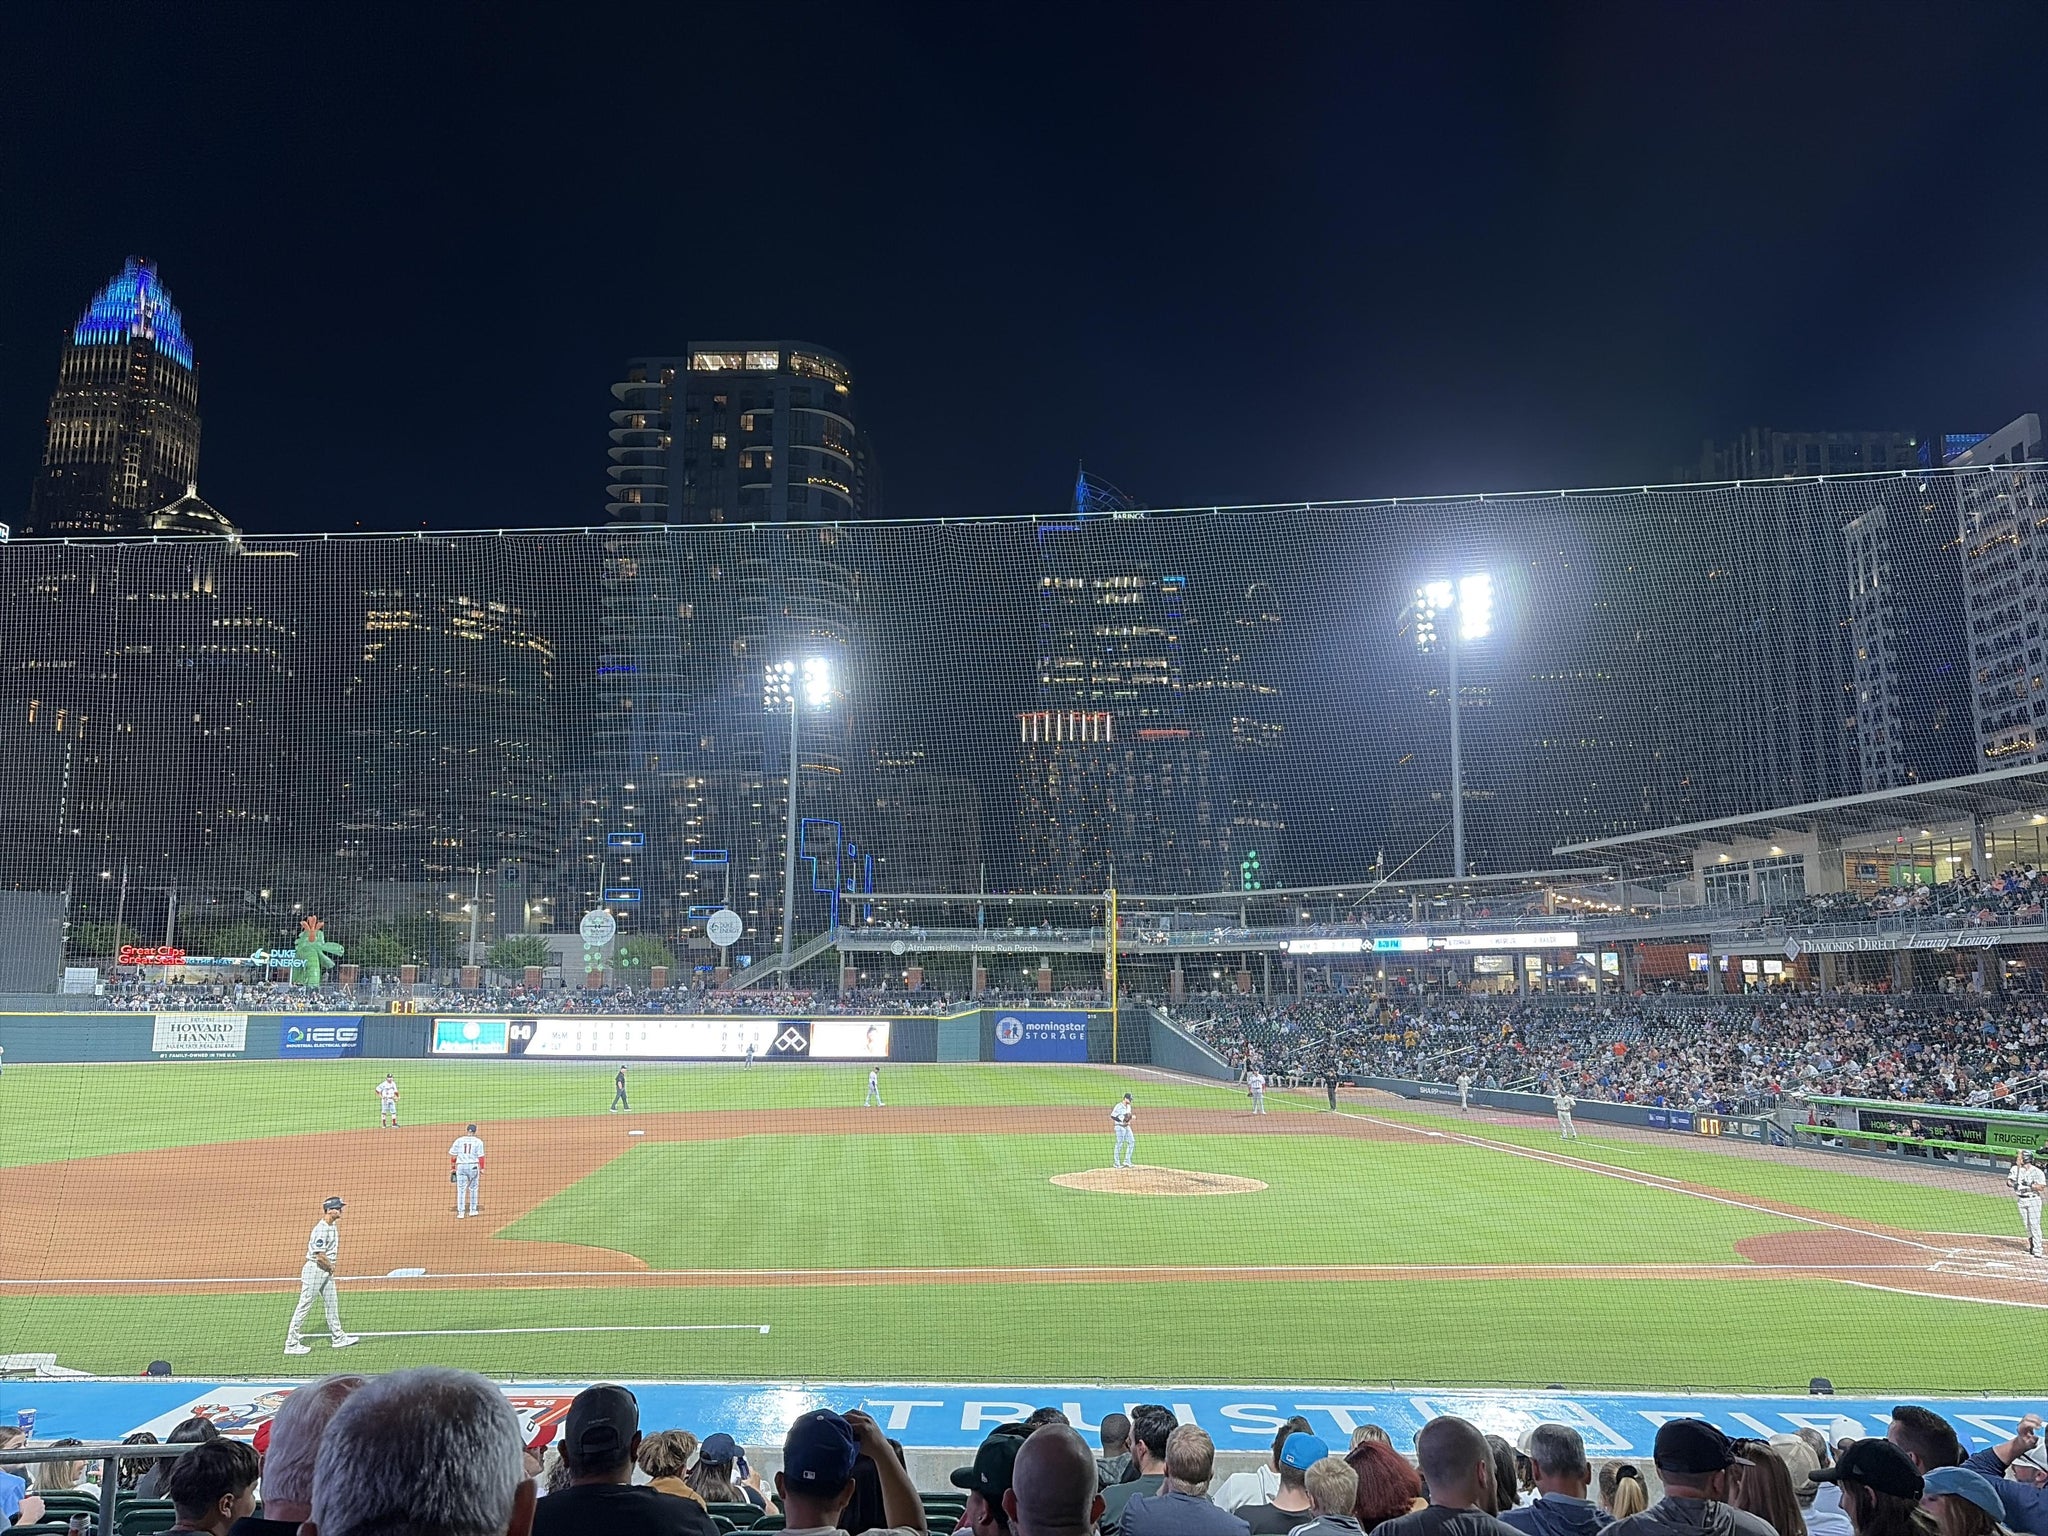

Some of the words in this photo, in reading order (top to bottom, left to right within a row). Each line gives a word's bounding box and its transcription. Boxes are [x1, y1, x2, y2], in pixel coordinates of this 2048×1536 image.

[1803, 939, 1855, 953] DIAMONDS
[1858, 936, 1898, 951] DIRECT
[1903, 933, 1950, 952] Luxury
[1950, 930, 2001, 950] Lounge
[120, 945, 156, 955] Great
[158, 946, 185, 956] Clips
[270, 949, 296, 957] DUKE
[1014, 944, 1038, 952] Porch
[118, 955, 154, 964] Great
[154, 955, 186, 965] Seats
[269, 957, 308, 968] ENERGY
[171, 1024, 233, 1032] HOWARD
[1026, 1021, 1085, 1033] morningstar
[1025, 1032, 1085, 1040] STORAGE
[1961, 1129, 1982, 1140] WITH
[1994, 1132, 2037, 1146] TRUGREEN
[463, 1143, 472, 1155] 11
